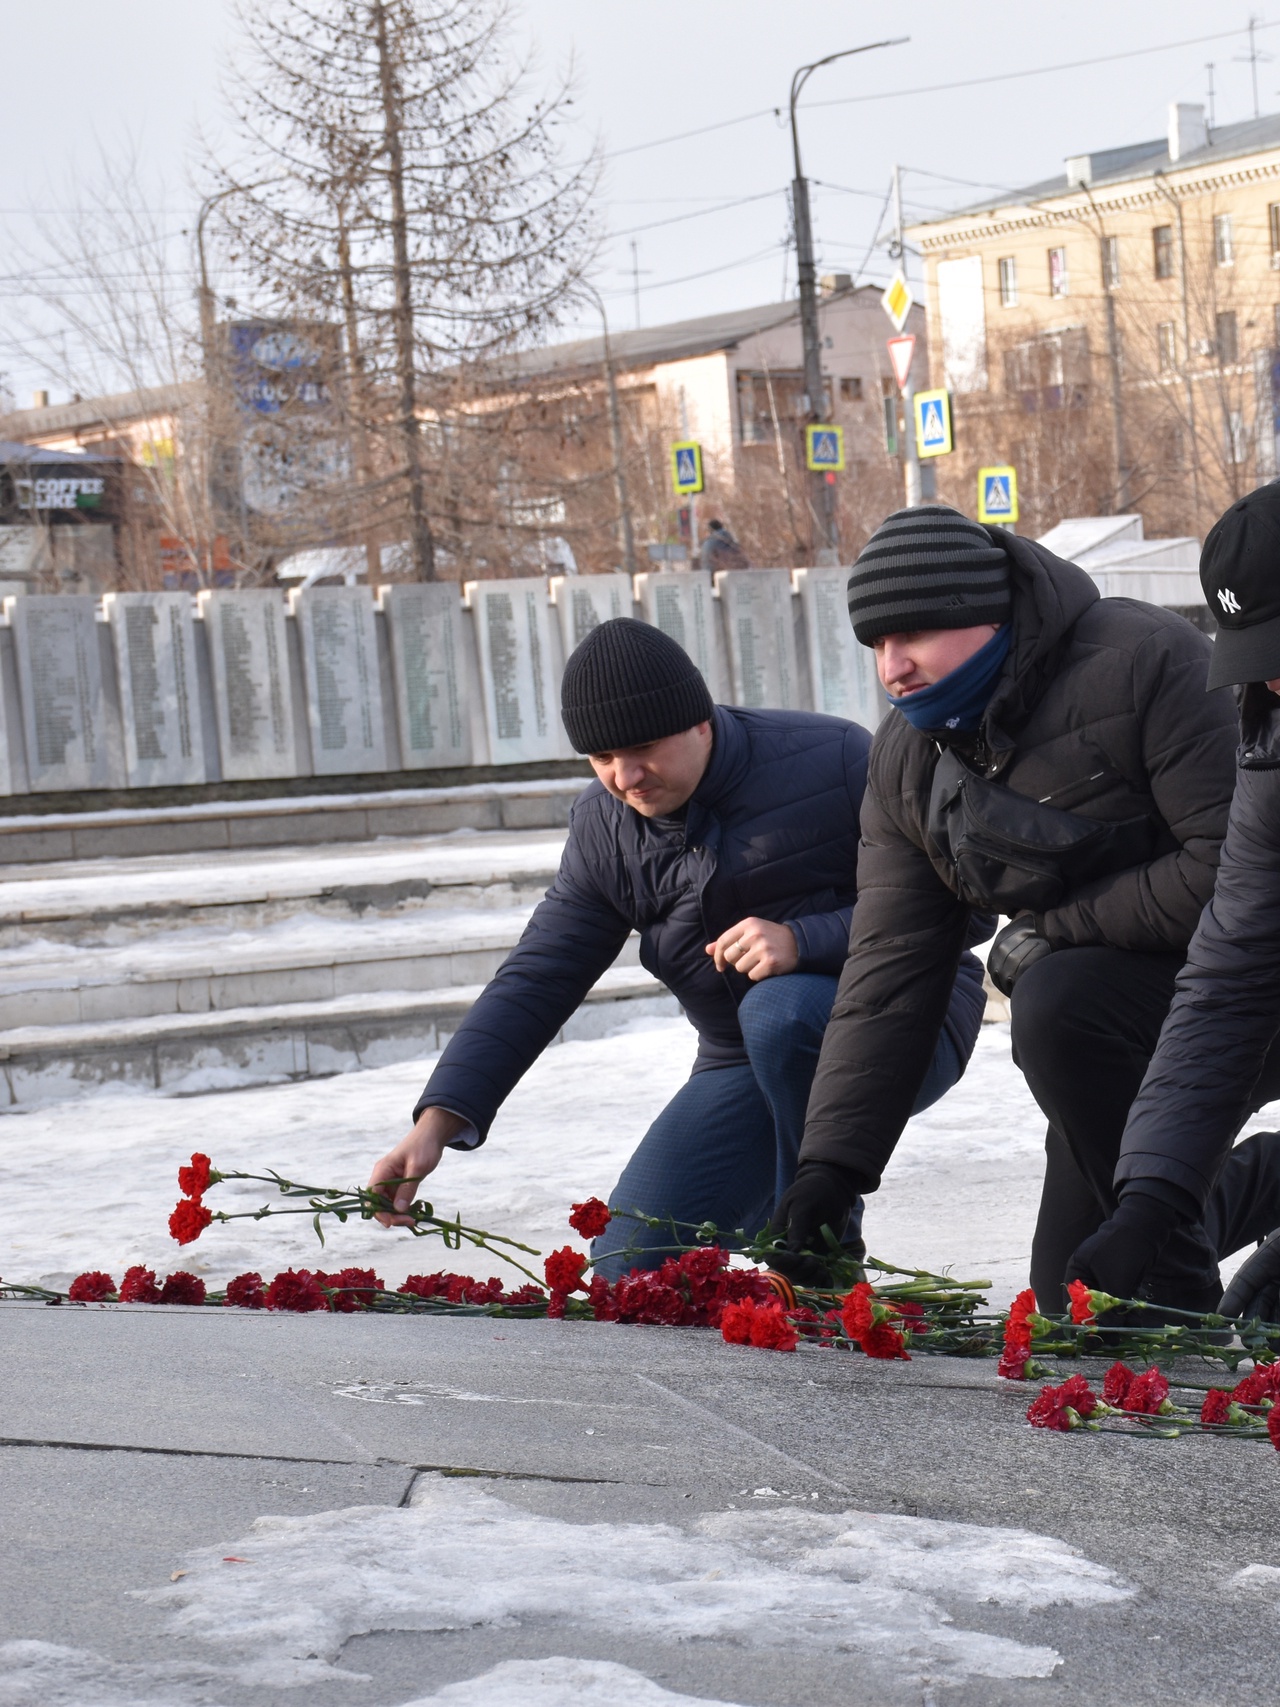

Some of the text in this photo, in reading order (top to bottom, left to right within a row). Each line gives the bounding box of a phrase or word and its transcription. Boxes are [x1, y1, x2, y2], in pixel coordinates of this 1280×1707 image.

[34, 478, 104, 494] COFFEE
[35, 494, 77, 509] LIKE
[1217, 588, 1241, 614] NY
